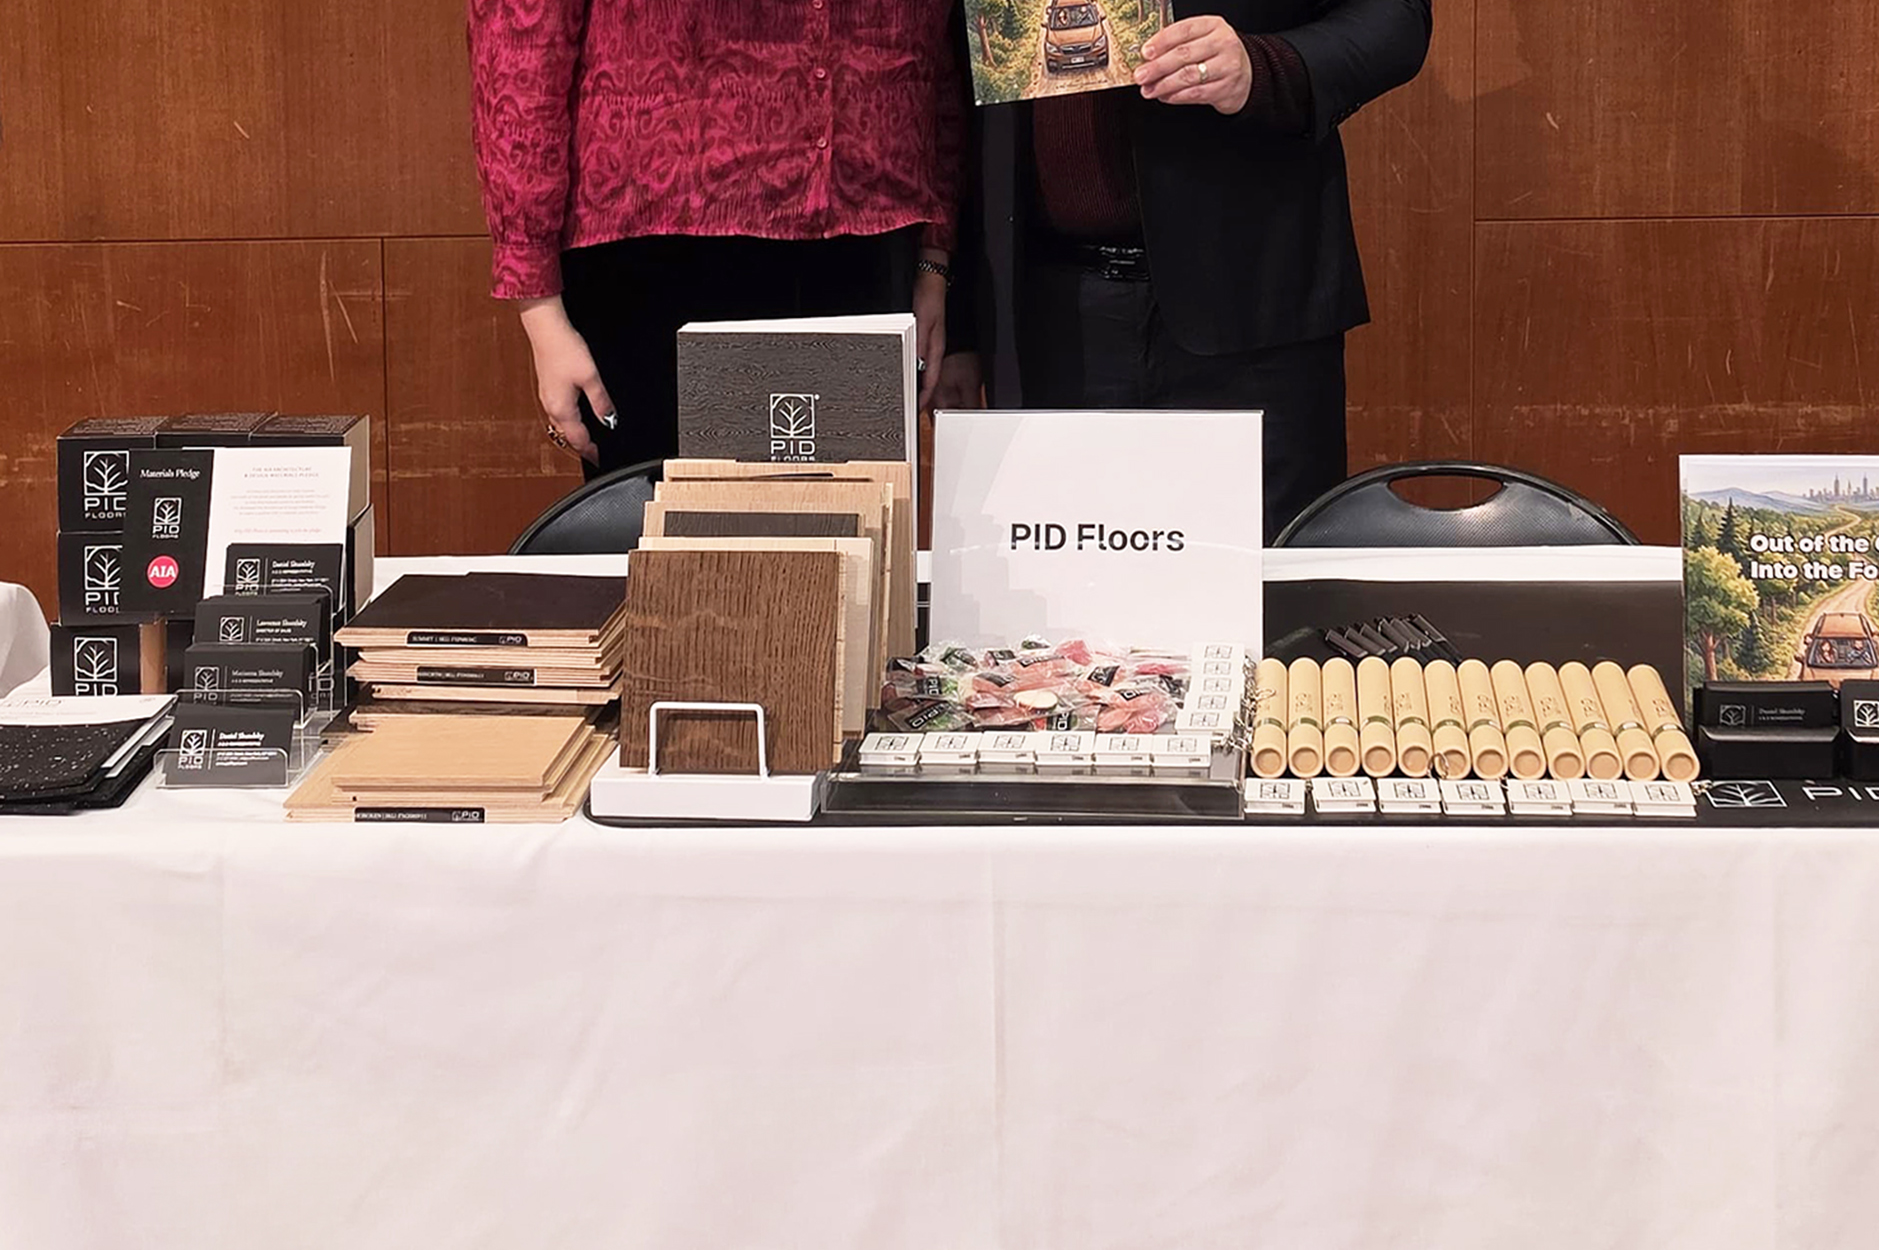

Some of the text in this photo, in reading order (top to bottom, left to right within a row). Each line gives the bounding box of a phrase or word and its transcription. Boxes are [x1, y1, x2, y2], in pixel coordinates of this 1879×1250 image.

[771, 440, 816, 455] PID
[140, 469, 200, 480] Materials Pledge
[1011, 523, 1185, 551] PID Floors
[1750, 534, 1870, 553] Out of the
[150, 565, 177, 578] AIA
[1750, 561, 1799, 580] Into
[1803, 561, 1843, 580] the
[75, 682, 118, 696] PID
